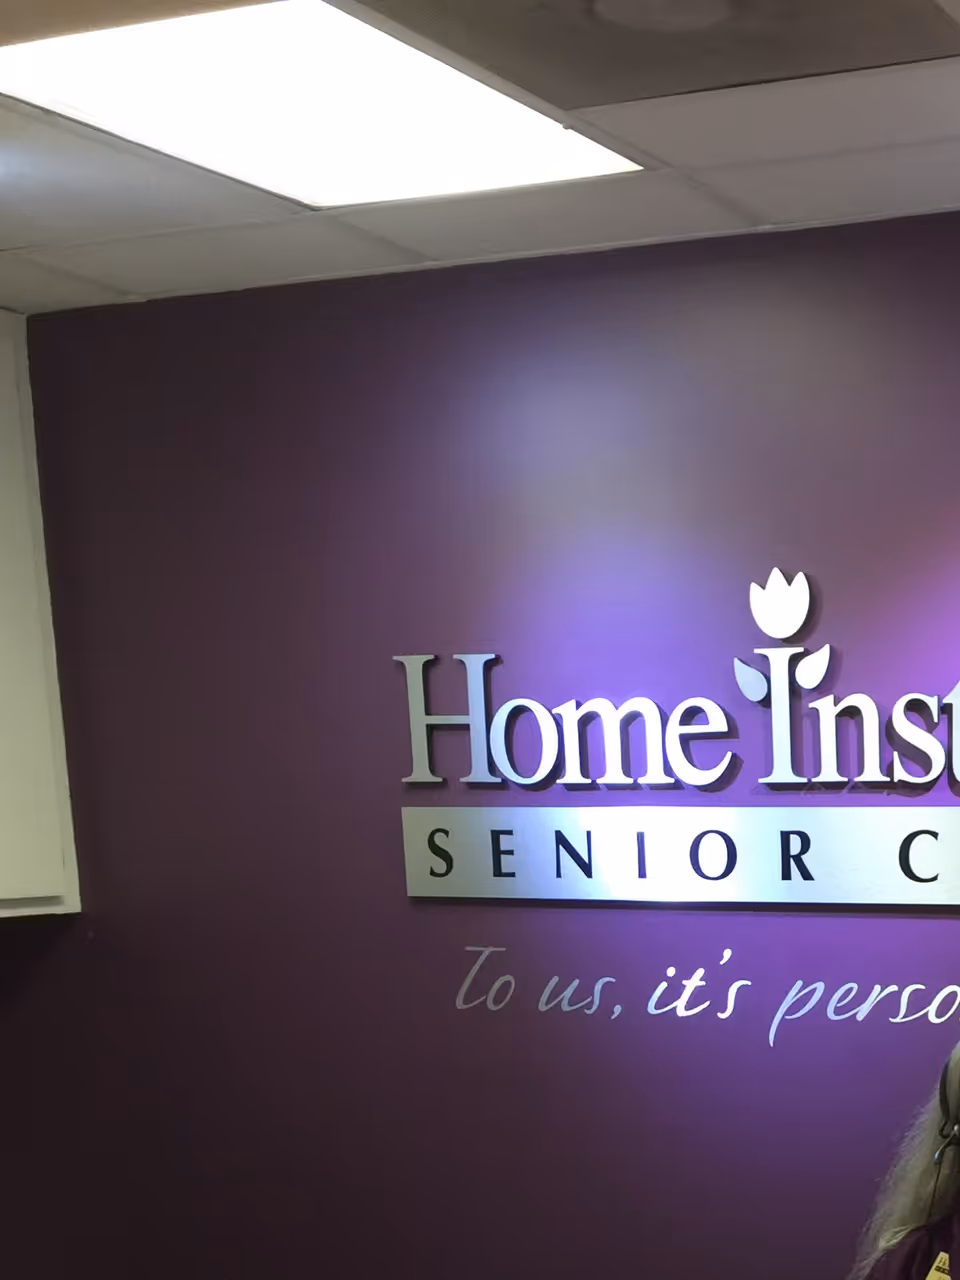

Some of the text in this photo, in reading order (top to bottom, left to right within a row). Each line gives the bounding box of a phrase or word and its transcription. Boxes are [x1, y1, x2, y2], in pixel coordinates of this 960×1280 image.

[393, 653, 733, 786] Home
[427, 827, 815, 881] SENIOR
[455, 946, 515, 1011] To
[538, 974, 622, 1020] us,
[646, 947, 752, 1018] it's
